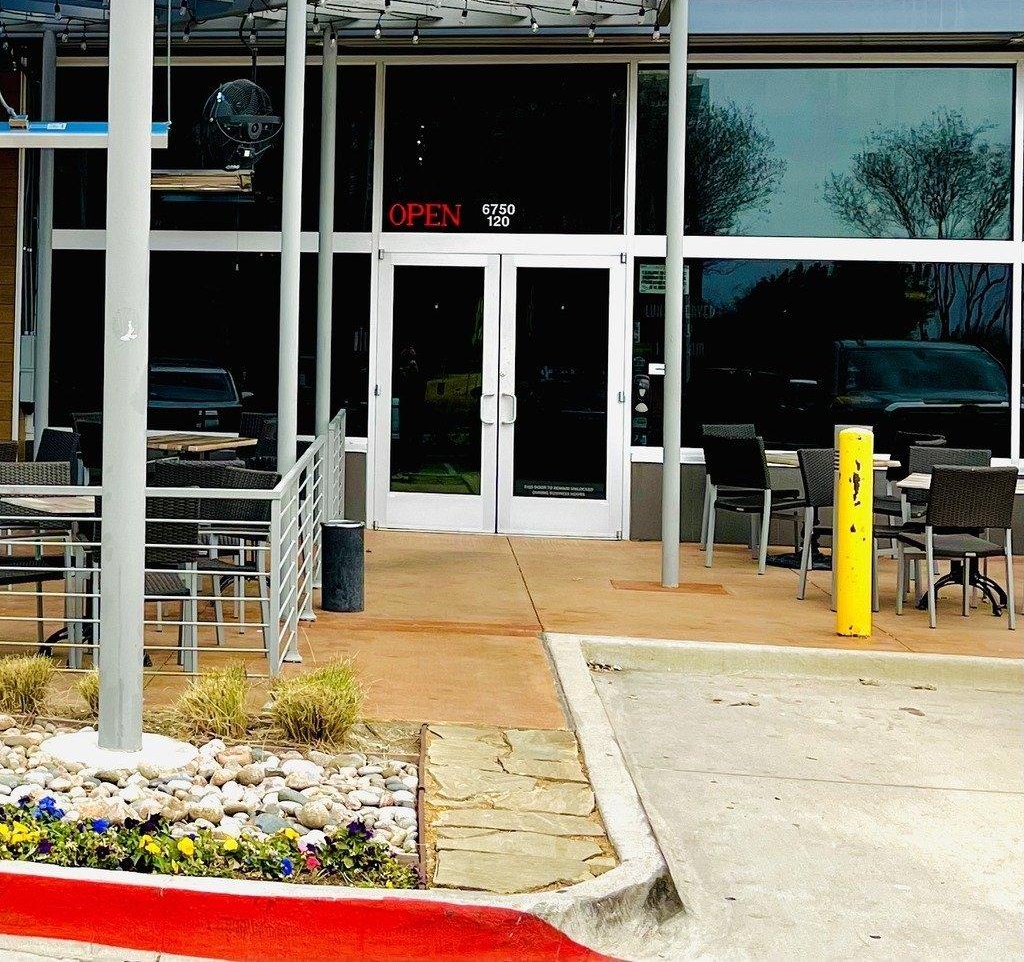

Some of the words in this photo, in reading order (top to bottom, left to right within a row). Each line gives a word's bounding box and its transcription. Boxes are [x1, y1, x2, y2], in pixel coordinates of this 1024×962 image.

[389, 203, 462, 227] OPEN
[482, 203, 516, 215] 6750
[486, 215, 510, 227] 120
